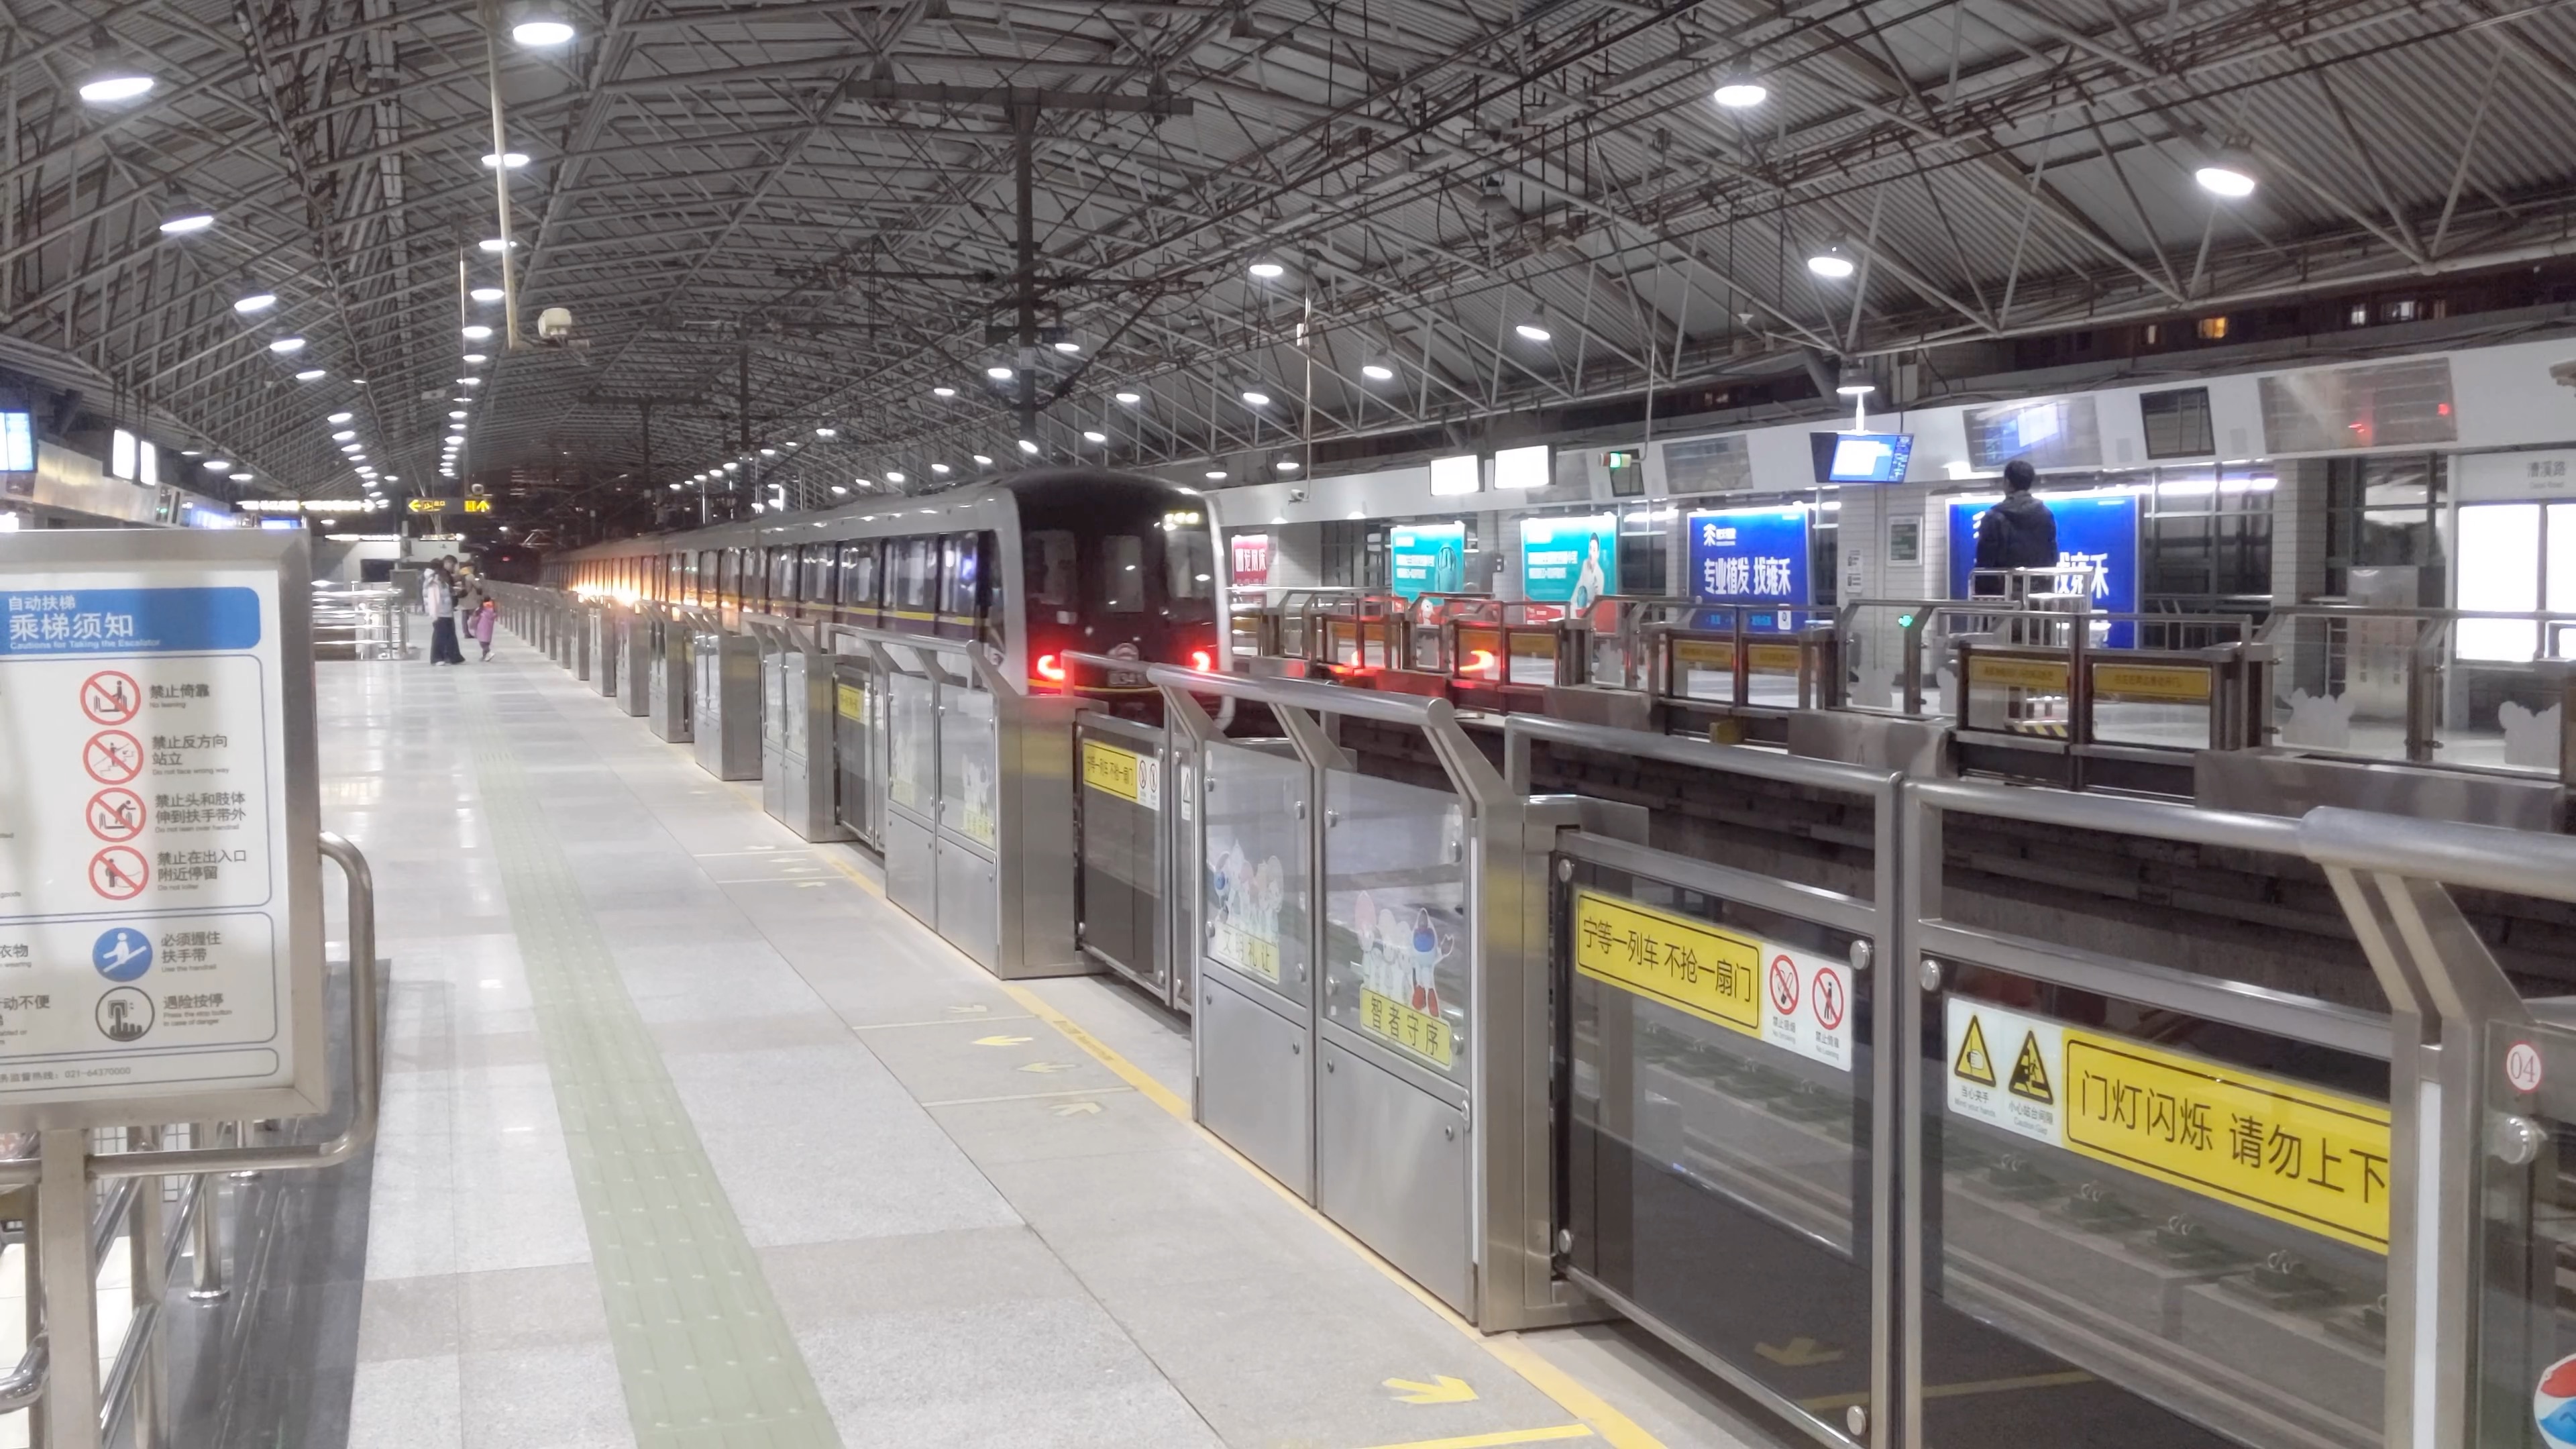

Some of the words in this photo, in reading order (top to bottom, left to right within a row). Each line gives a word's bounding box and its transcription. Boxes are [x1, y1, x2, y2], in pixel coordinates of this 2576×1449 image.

[1704, 557, 1750, 594] 专业植发
[1754, 556, 1791, 596] 找雍禾
[9, 595, 76, 612] 自动扶梯
[9, 612, 133, 641] 乘梯须知
[10, 641, 51, 650] Cautions
[53, 641, 66, 649] for
[70, 640, 99, 649] Taking
[101, 639, 115, 647] the
[118, 639, 160, 647] Escalator
[150, 684, 209, 699] 禁止倚靠
[152, 734, 227, 750] 禁止反方向
[152, 752, 182, 765] 站立
[155, 792, 246, 808] 禁止头和肢体
[156, 808, 246, 824] 伸到扶手带外
[157, 849, 246, 866] 禁止在出入口
[158, 865, 218, 882] 附近停留
[161, 930, 222, 947] 必须握住
[162, 947, 207, 964] 扶手带
[1223, 928, 1271, 973] 文明礼让
[1583, 916, 1659, 970] 宁等一列车
[1664, 942, 1751, 1002] 不抢一扇门
[163, 994, 223, 1010] 遇险按停
[1371, 995, 1439, 1056] 智者守序
[2510, 1051, 2536, 1083] 04
[1961, 1085, 1989, 1104] 当心夹手
[2082, 1070, 2212, 1152] 门灯闪烁
[2229, 1112, 2389, 1203] 请勿上下
